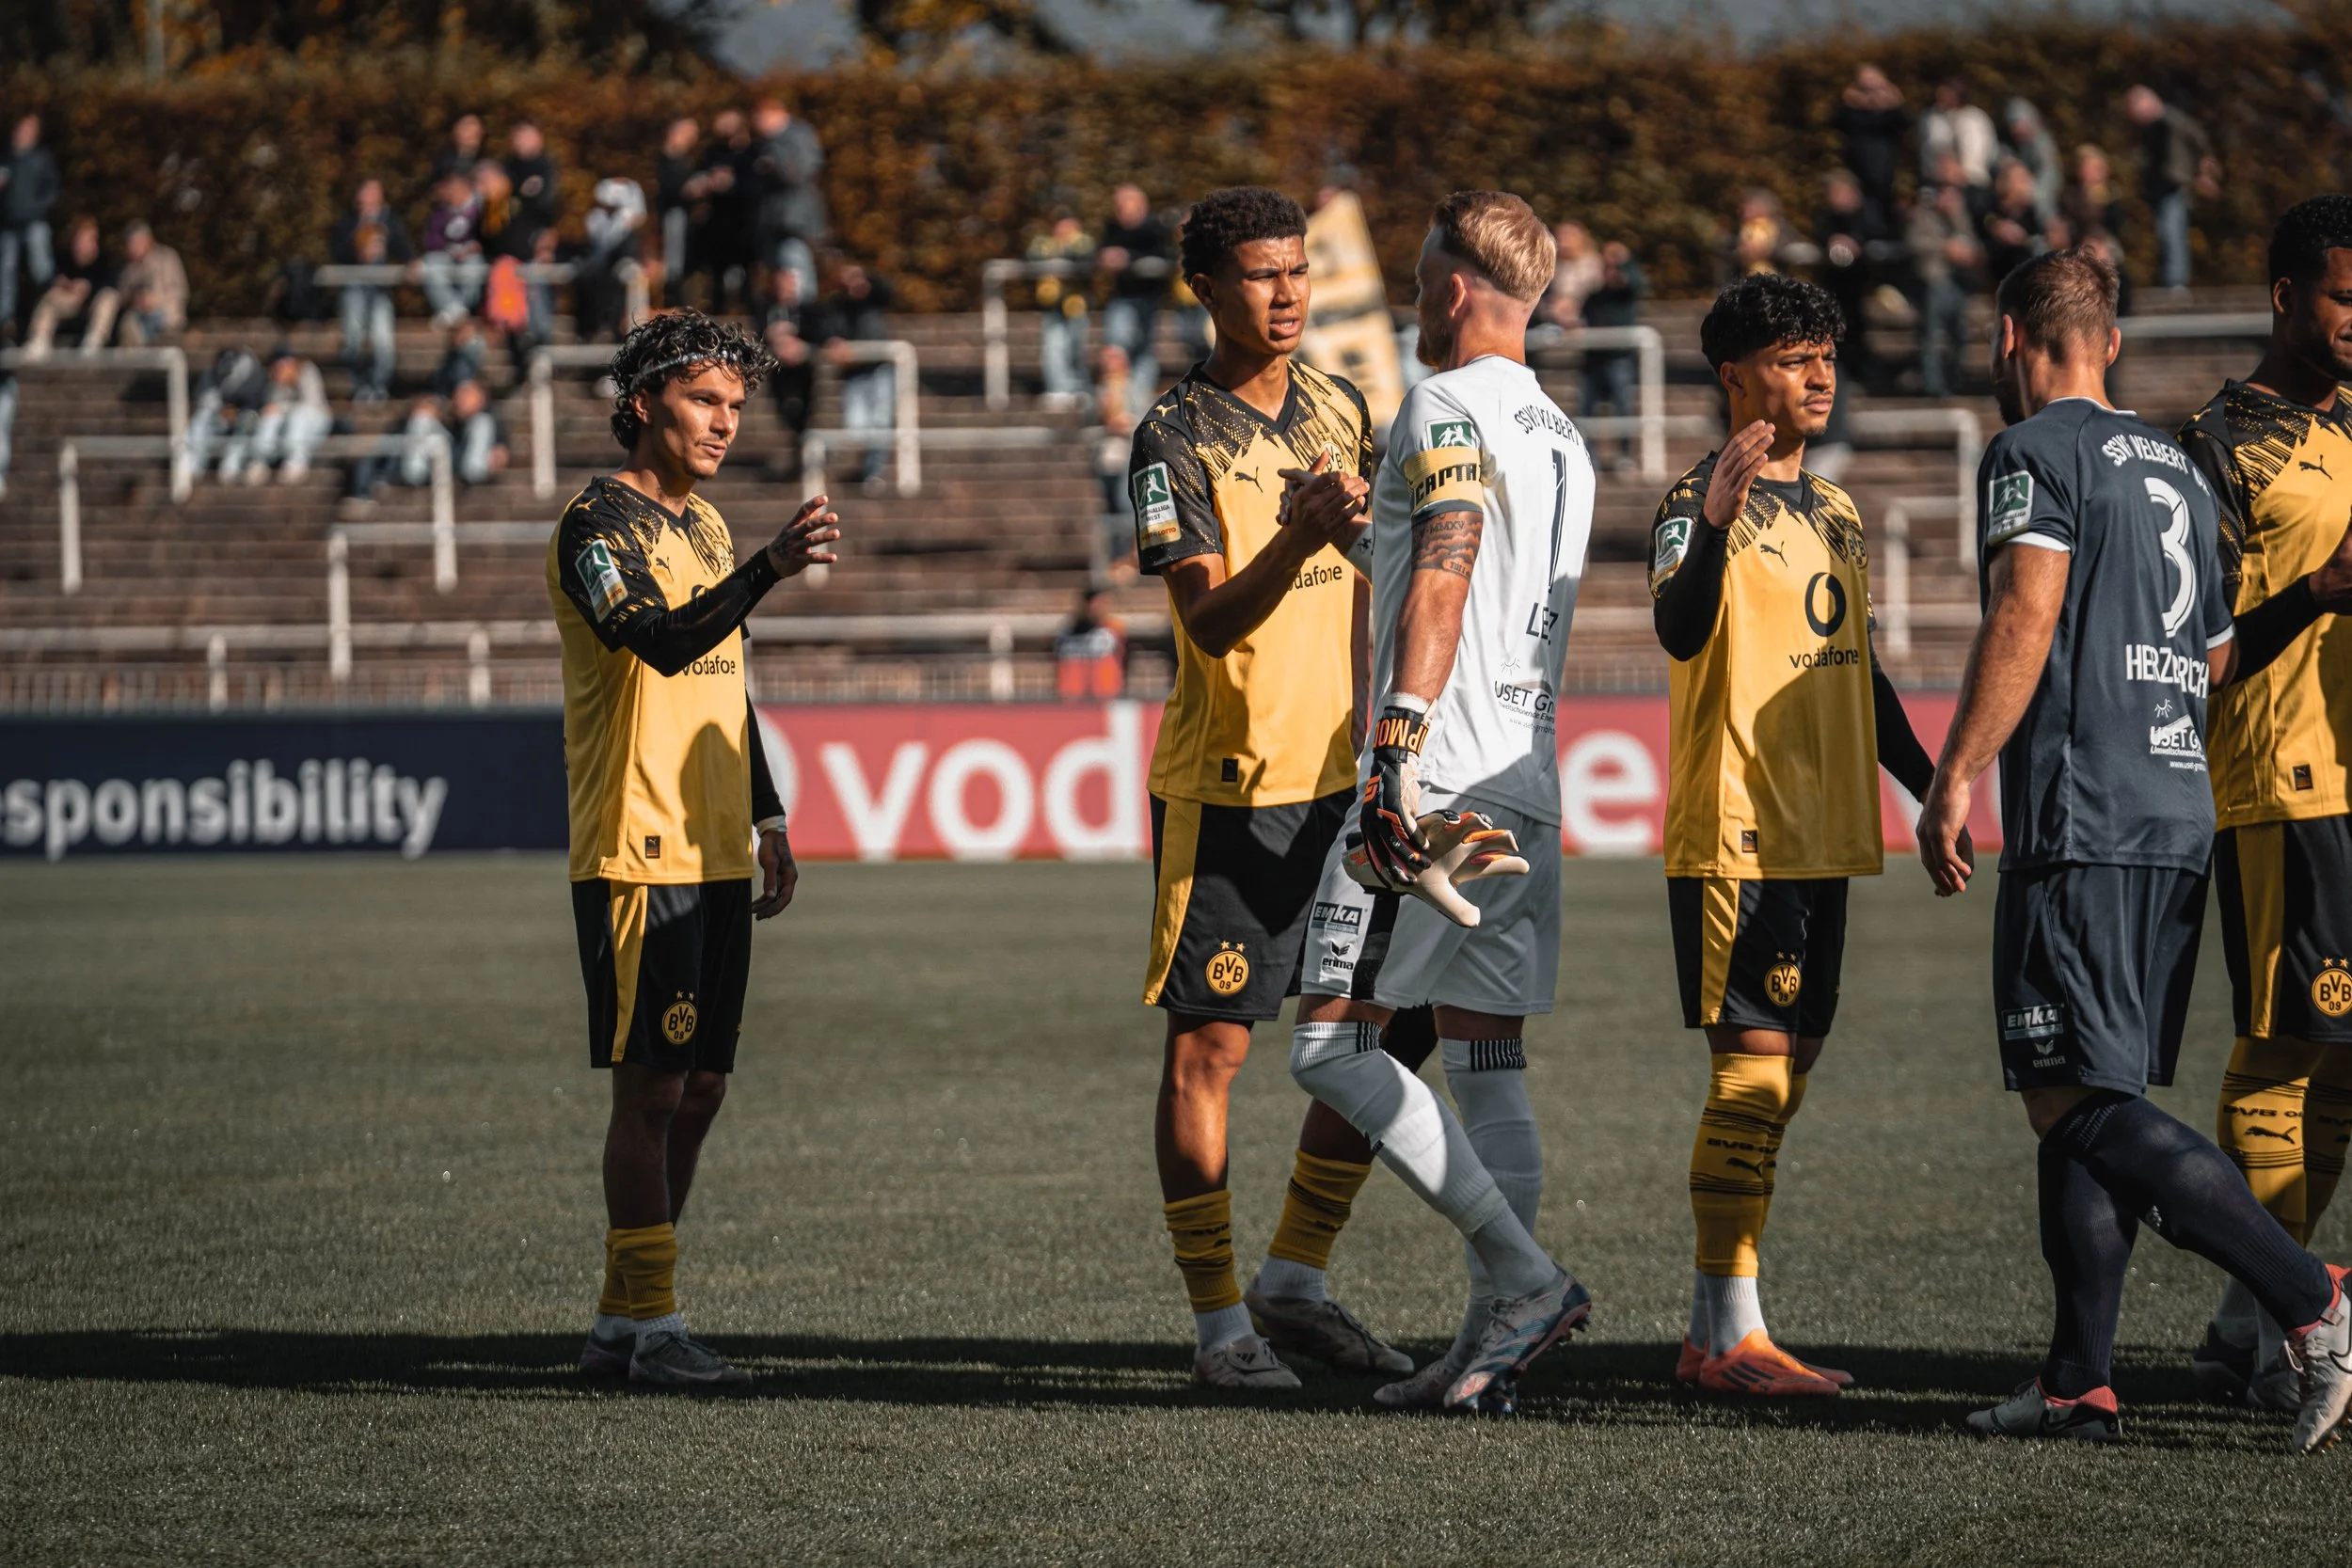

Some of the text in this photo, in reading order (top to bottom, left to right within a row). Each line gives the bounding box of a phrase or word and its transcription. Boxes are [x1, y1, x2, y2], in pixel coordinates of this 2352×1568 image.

[2128, 434, 2189, 474] VELBERT
[1414, 462, 1482, 506] CAPTA
[1548, 447, 1567, 594] 1
[2144, 477, 2197, 639] 3
[1289, 565, 1343, 591] dafone
[1494, 680, 1533, 707] USET
[2150, 726, 2187, 748] USET
[0, 756, 450, 861] sponsibility
[1212, 955, 1244, 984] BVB
[1322, 957, 1354, 971] erima
[1218, 979, 1232, 990] 09
[1771, 965, 1797, 994] BVB
[2319, 974, 2352, 1003] BVB
[668, 1005, 694, 1033] BVB
[2328, 1000, 2342, 1011] 09
[674, 1030, 685, 1040] 09
